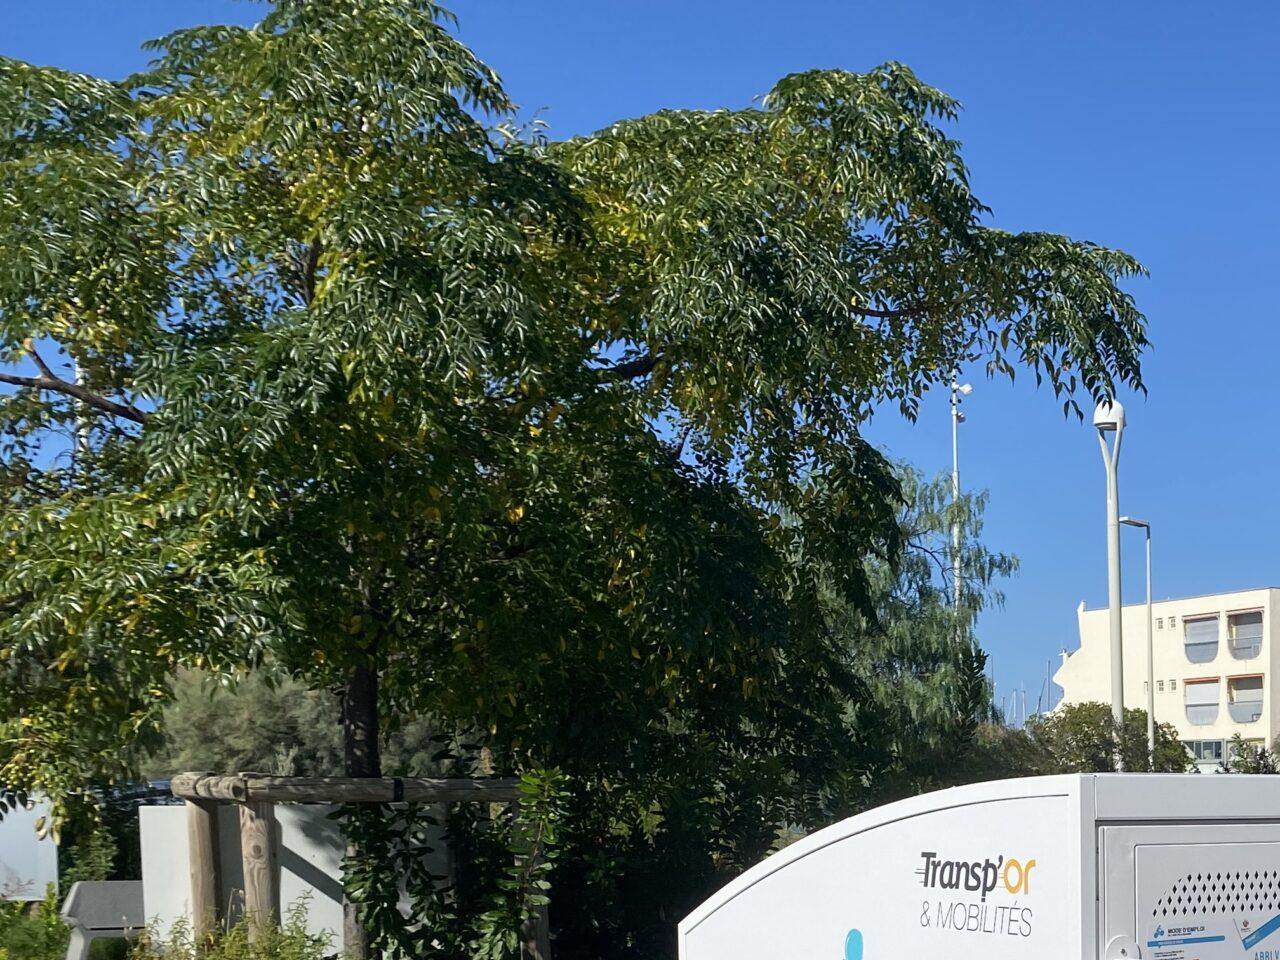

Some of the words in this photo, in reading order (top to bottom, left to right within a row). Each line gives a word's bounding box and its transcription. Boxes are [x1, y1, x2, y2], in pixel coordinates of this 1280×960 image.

[920, 852, 1036, 902] Transp'or
[920, 901, 930, 927] &
[937, 900, 1033, 937] MOBILITÉS
